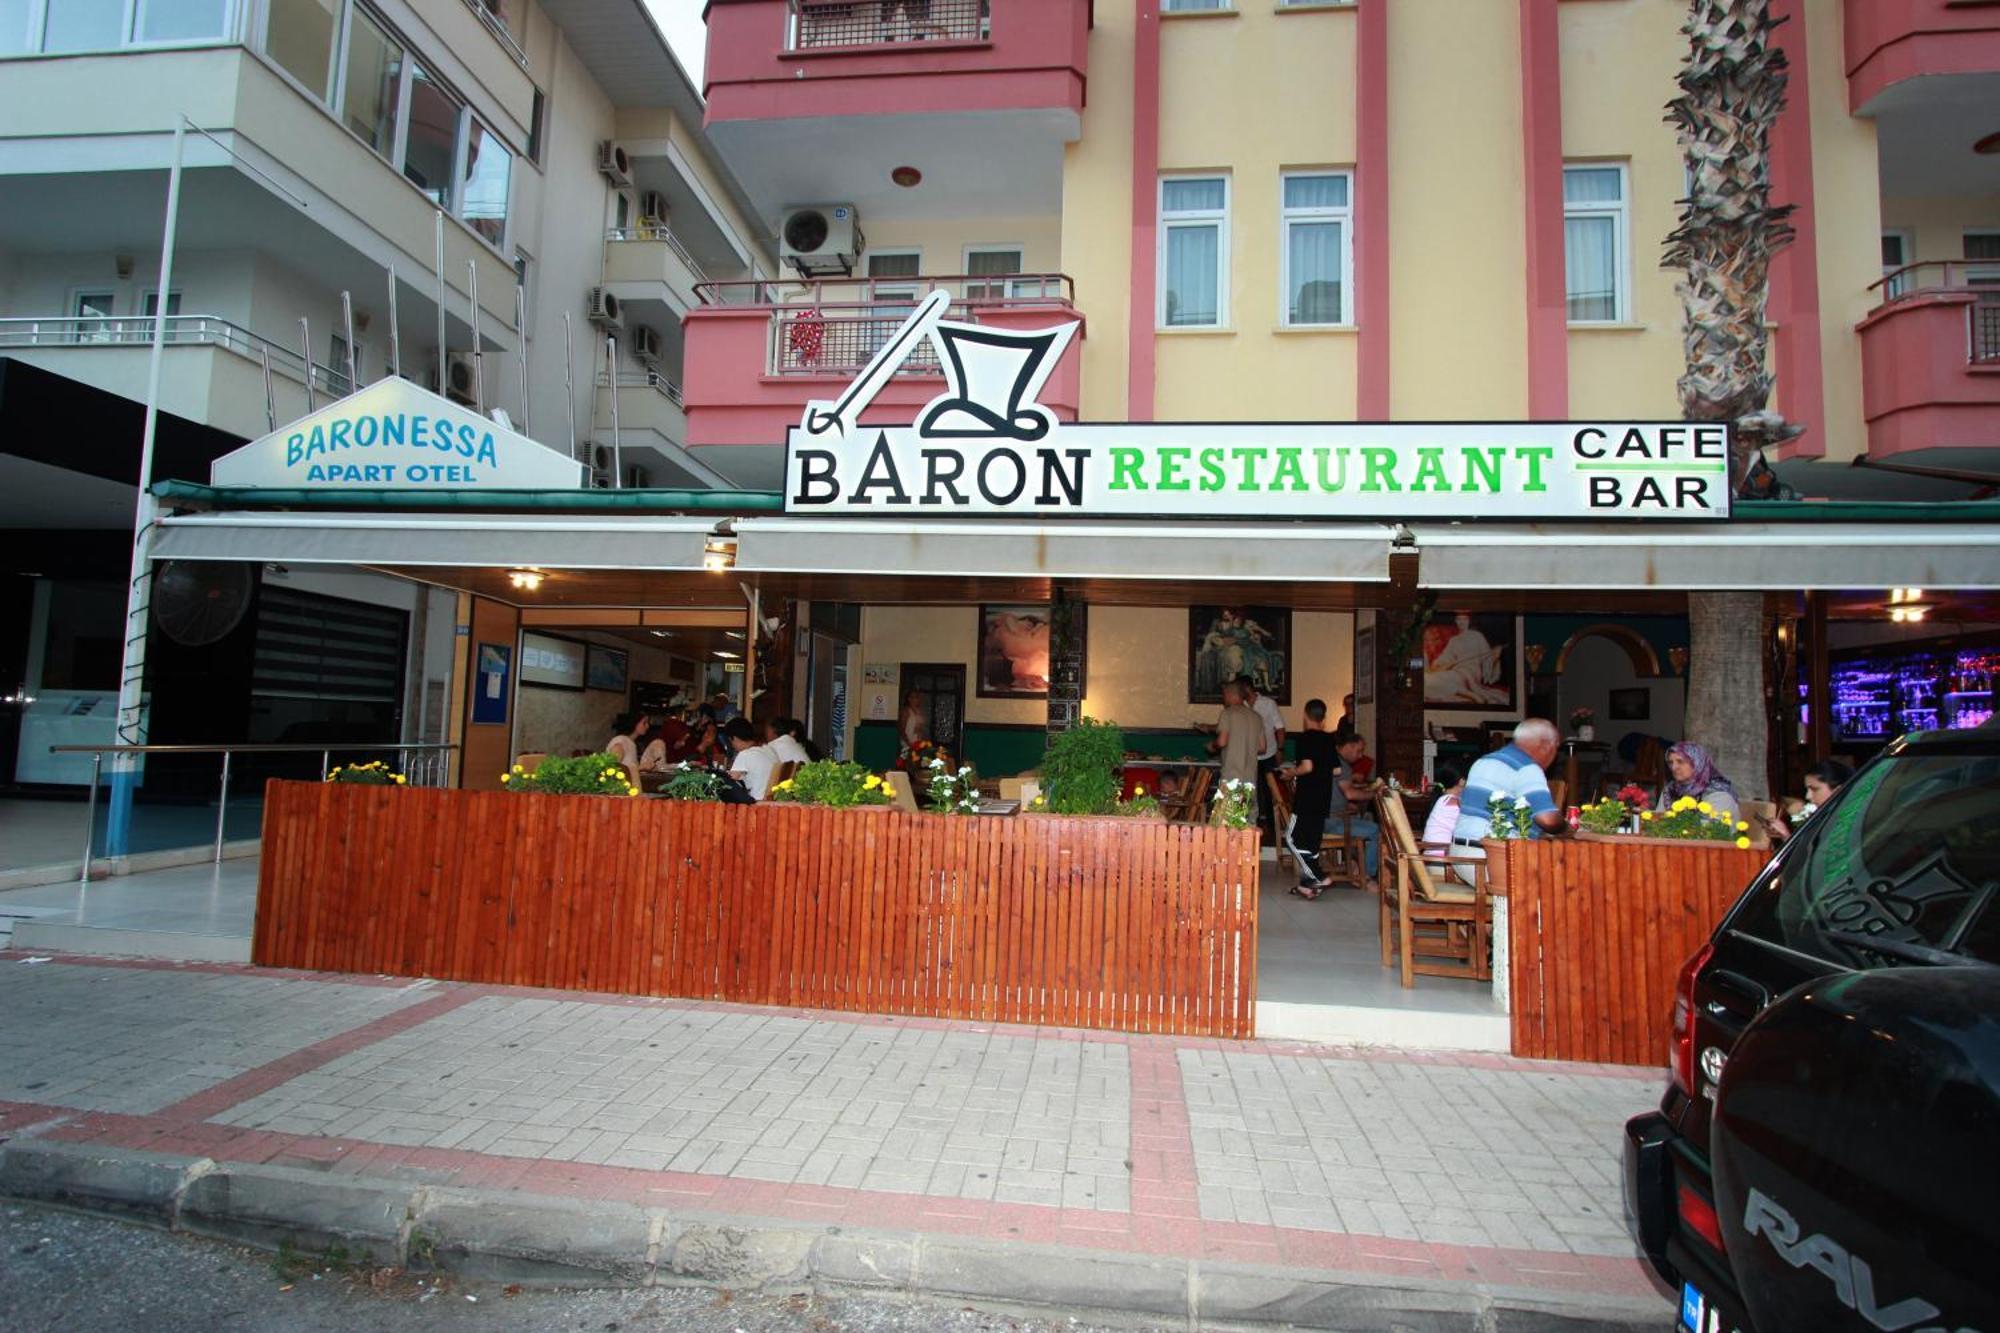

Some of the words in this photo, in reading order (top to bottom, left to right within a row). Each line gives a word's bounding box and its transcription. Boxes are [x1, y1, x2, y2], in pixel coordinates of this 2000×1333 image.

[287, 414, 497, 470] BARONESSA
[1573, 427, 1725, 459] CAFE
[307, 464, 396, 482] APART
[405, 464, 477, 482] OTEL
[792, 428, 1092, 506] BARON
[1108, 447, 1554, 493] RESTAURANT
[1589, 476, 1710, 508] BAR
[1743, 1187, 1983, 1333] RAV
